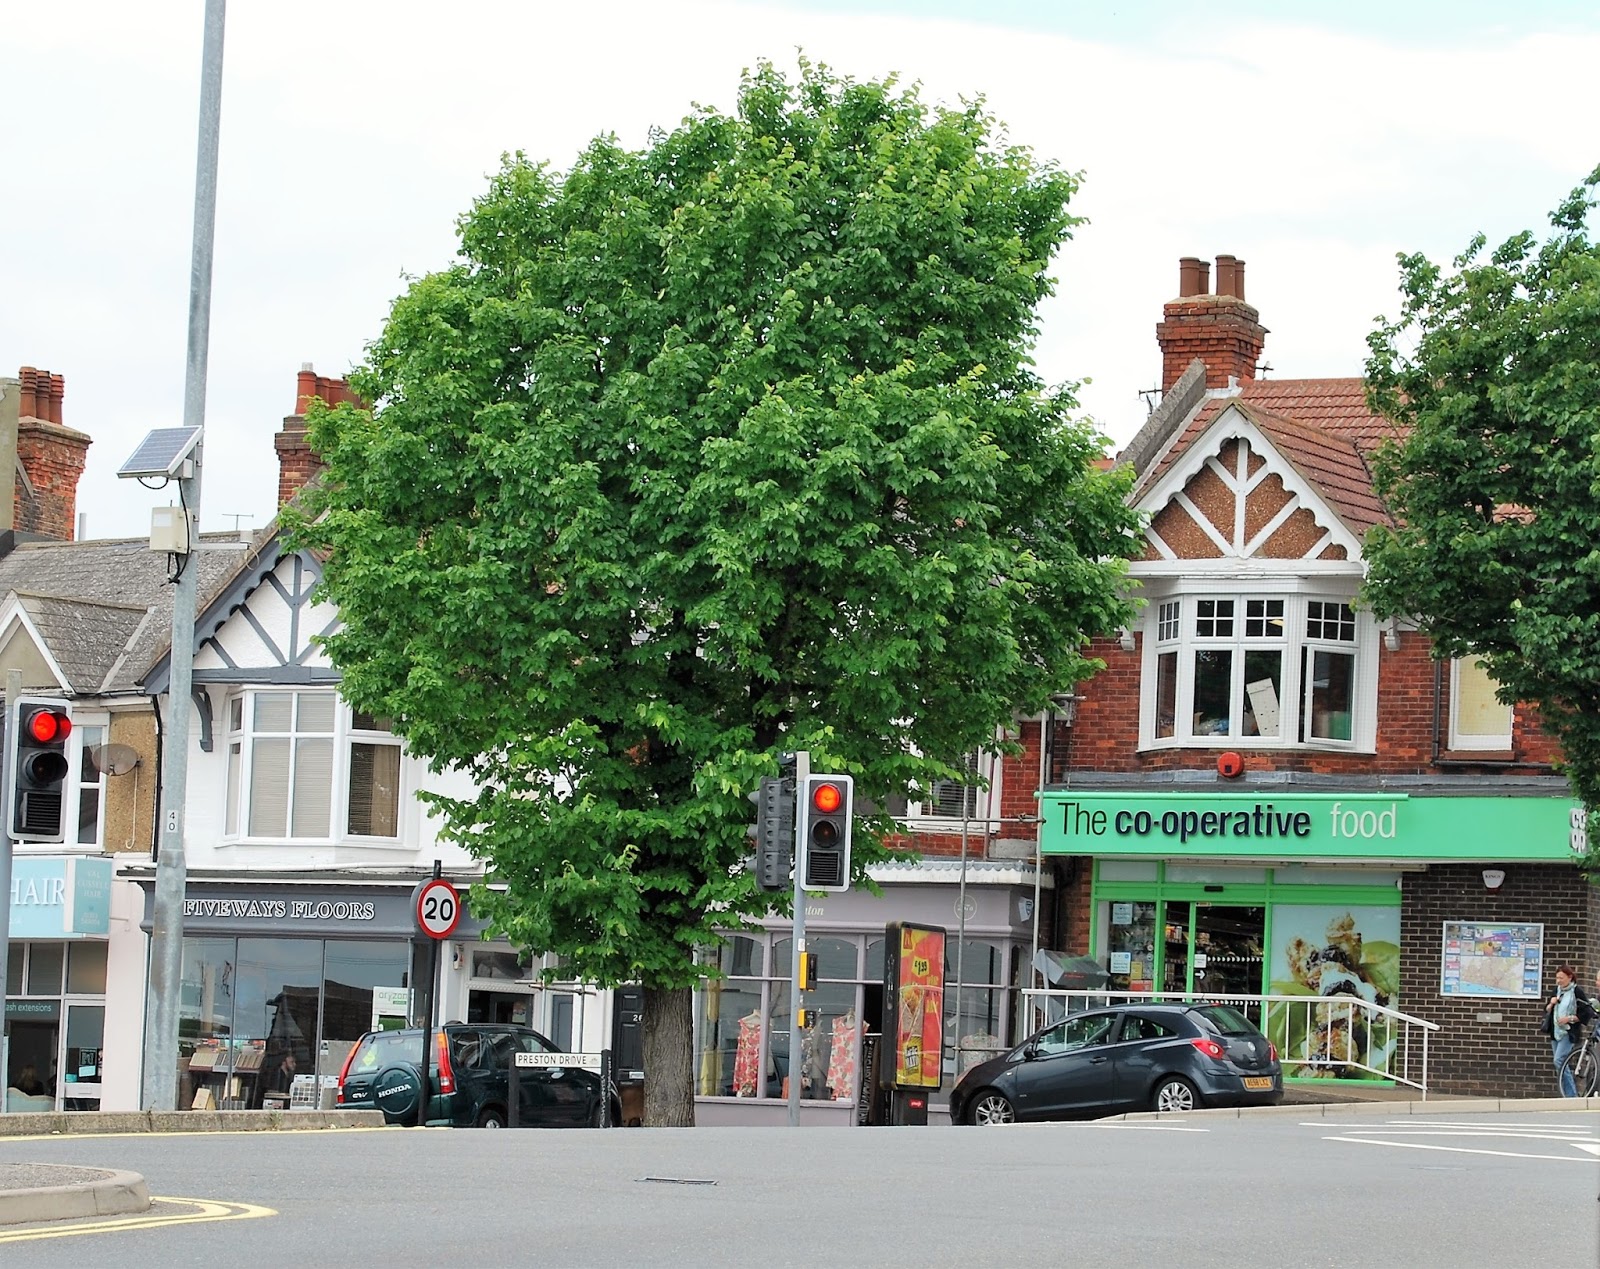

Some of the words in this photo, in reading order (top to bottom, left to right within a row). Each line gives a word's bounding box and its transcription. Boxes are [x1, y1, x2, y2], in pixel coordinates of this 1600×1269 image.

[1058, 803, 1106, 835] The
[1114, 804, 1311, 843] co-operative
[1330, 803, 1396, 838] food
[10, 878, 65, 905] HAIR
[183, 899, 286, 917] FIVEWAYS
[291, 901, 375, 920] FLOORS
[425, 897, 453, 921] 20
[18, 1003, 52, 1012] extensions
[518, 1054, 556, 1064] PRESTON
[560, 1055, 587, 1065] DROVE
[378, 1084, 411, 1098] HONDA
